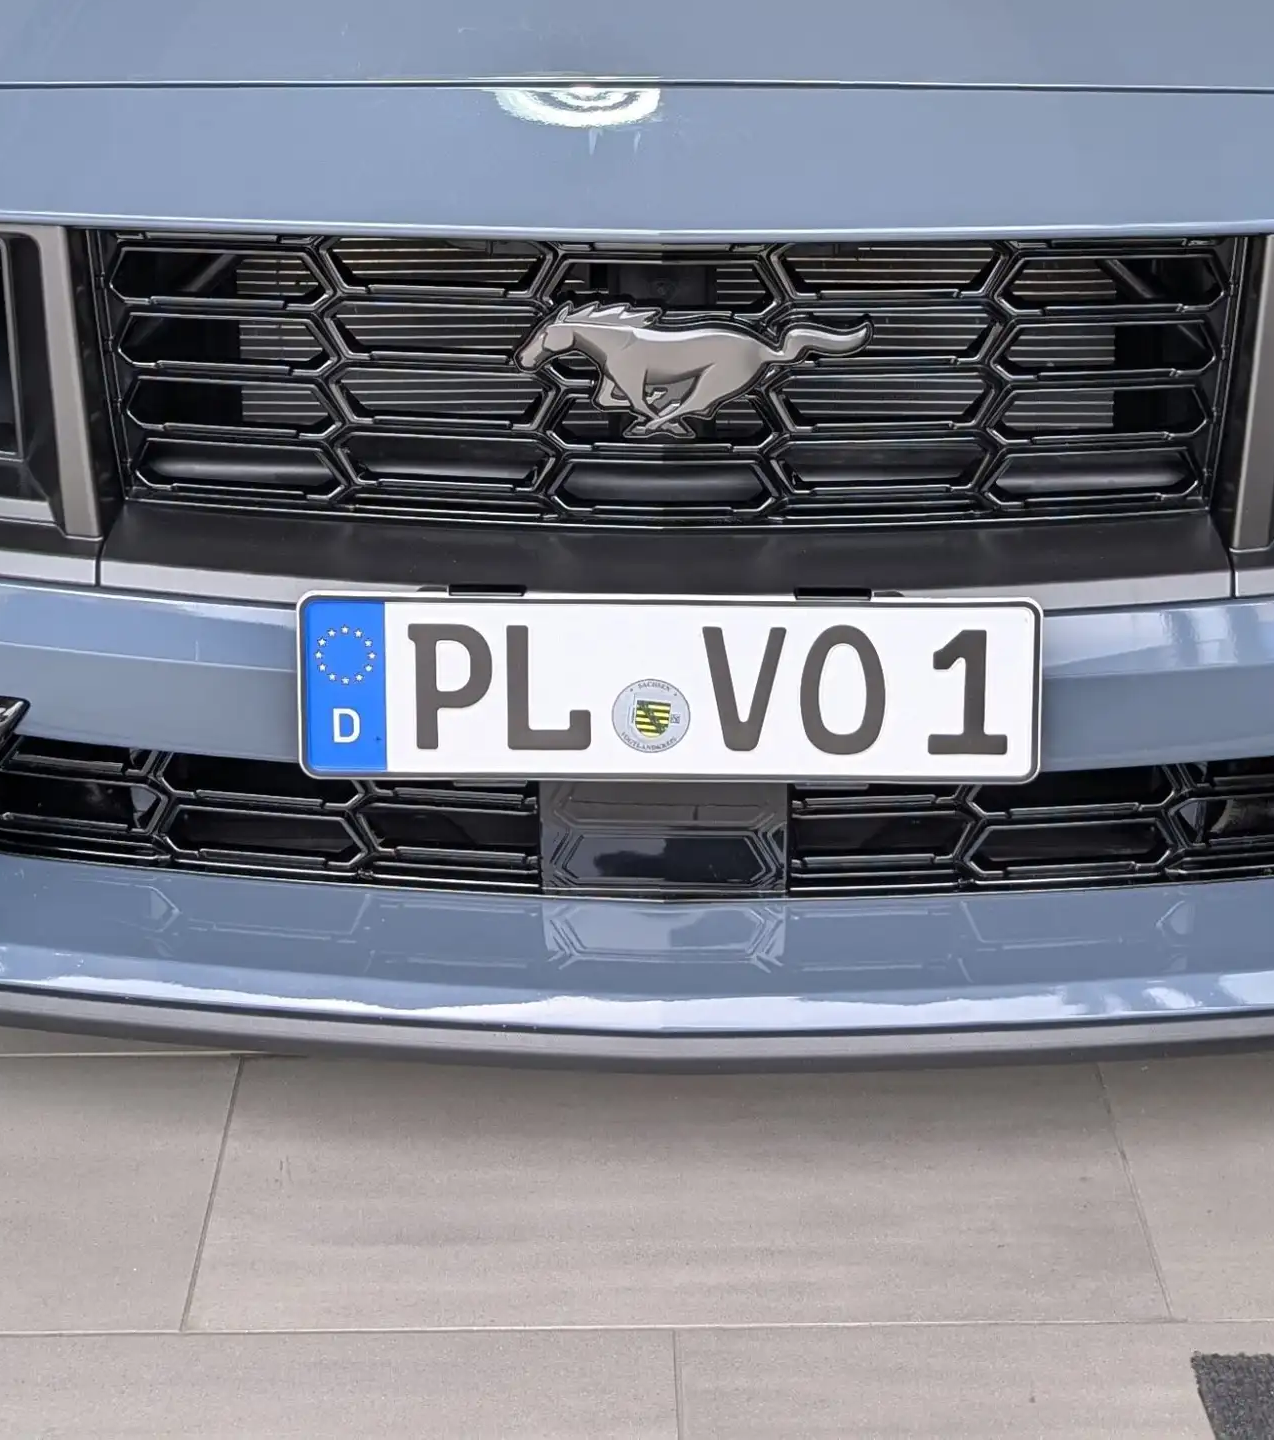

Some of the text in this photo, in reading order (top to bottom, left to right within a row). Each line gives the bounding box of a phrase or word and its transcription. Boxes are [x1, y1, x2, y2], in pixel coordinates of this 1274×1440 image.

[333, 708, 360, 743] D
[408, 623, 1008, 755] PL VO 1
